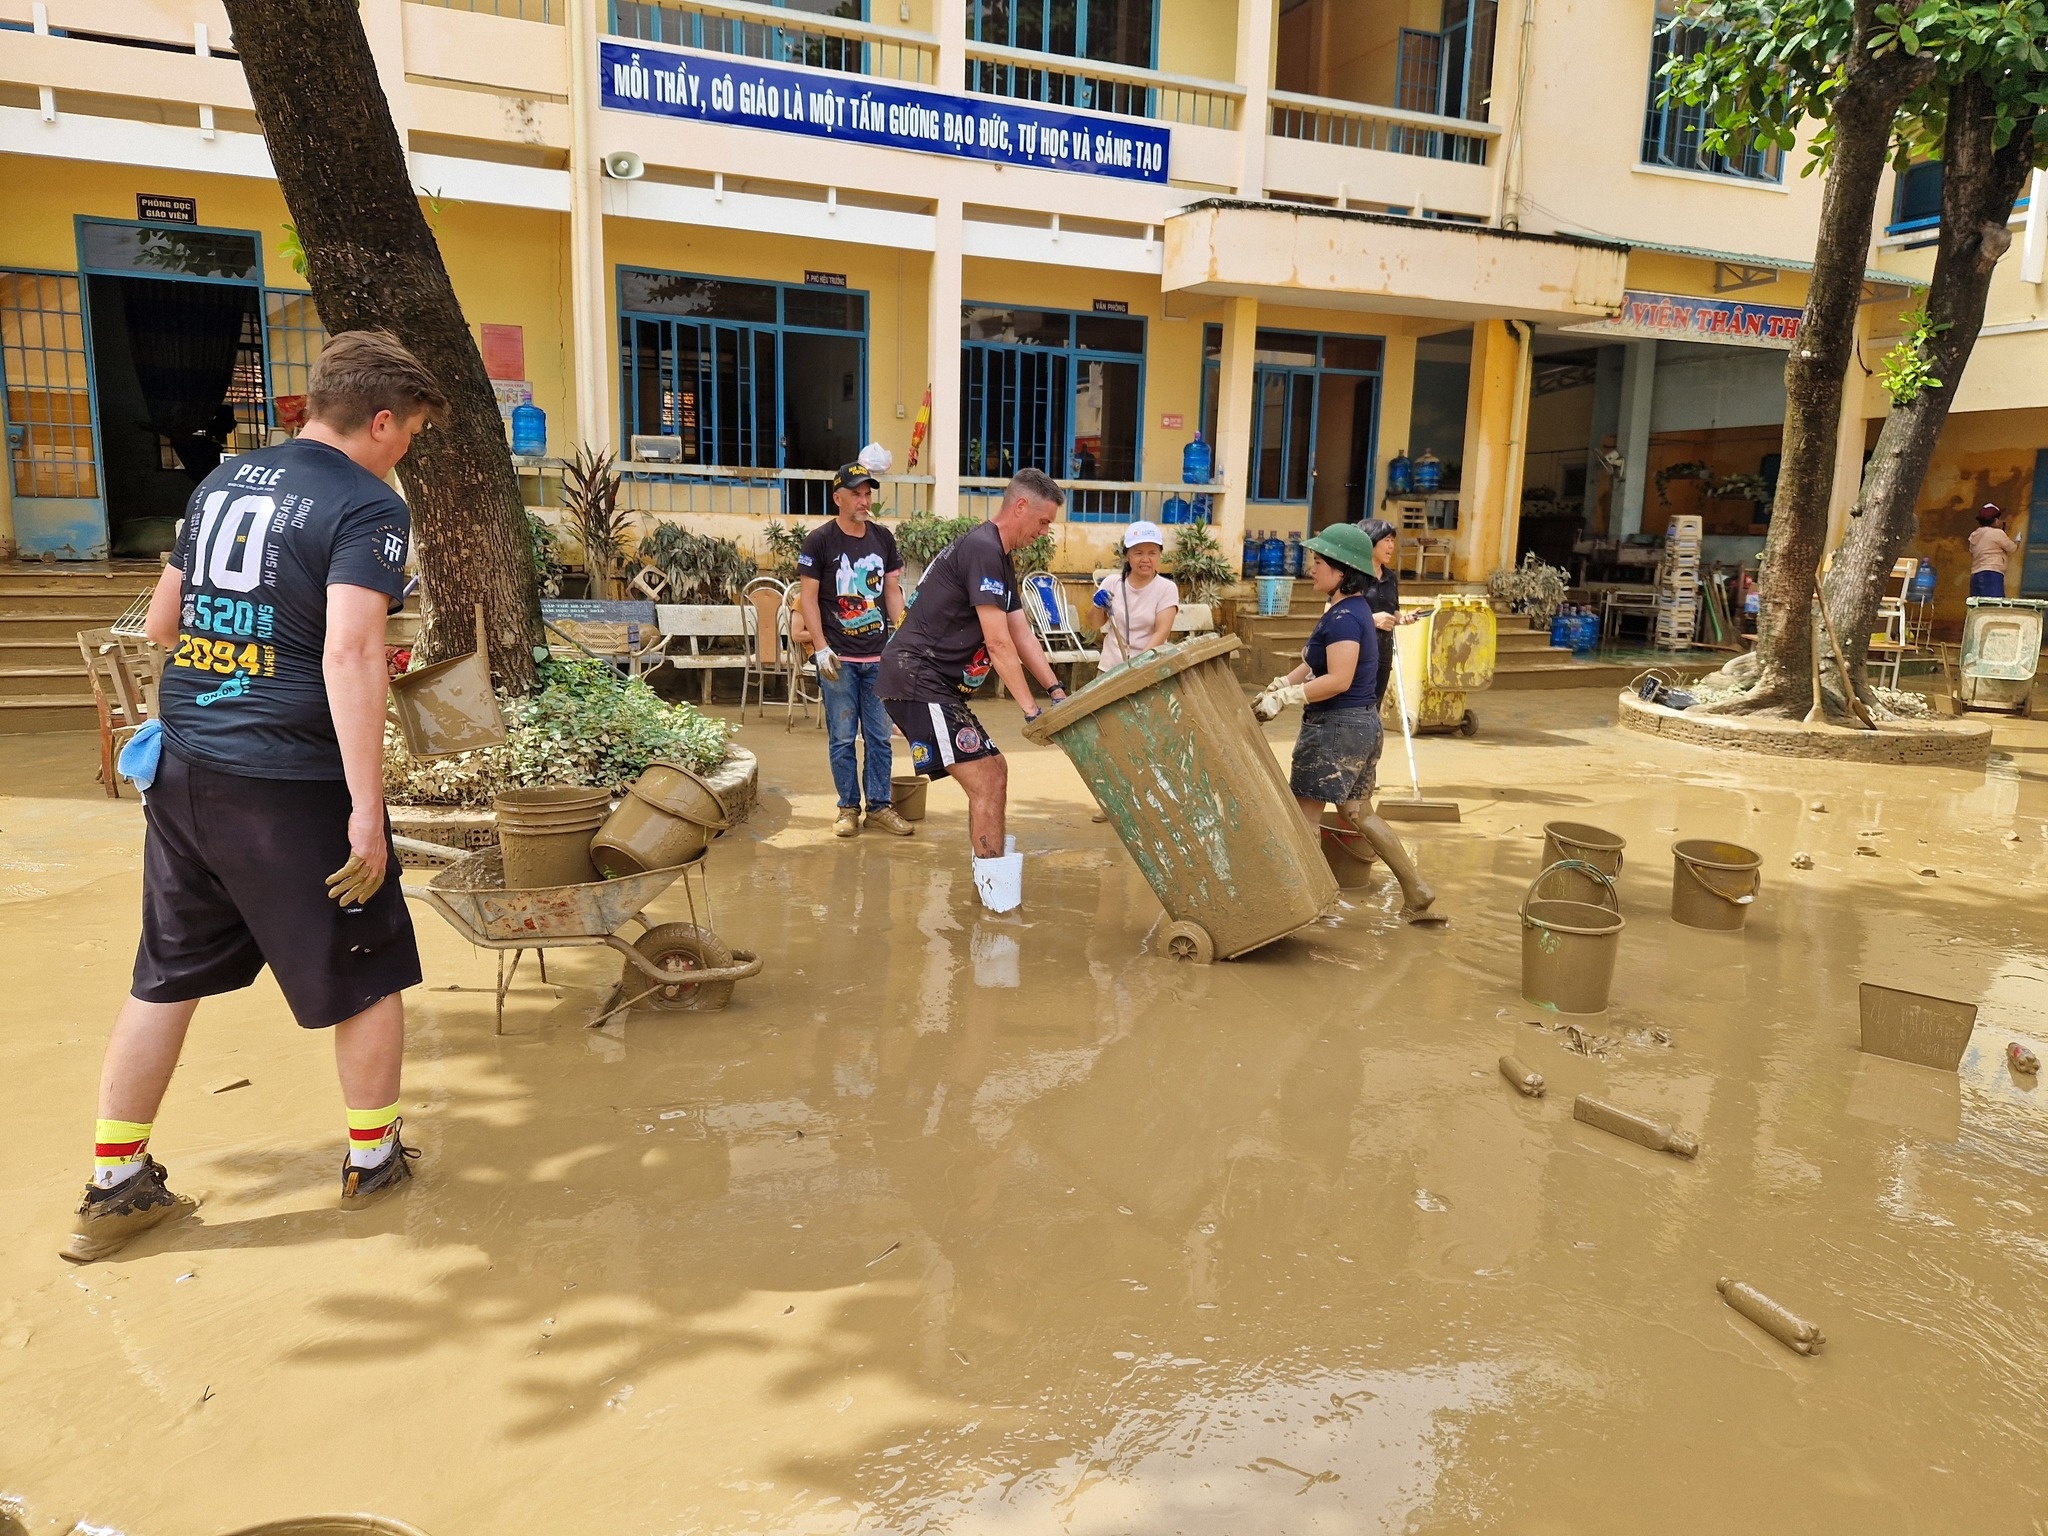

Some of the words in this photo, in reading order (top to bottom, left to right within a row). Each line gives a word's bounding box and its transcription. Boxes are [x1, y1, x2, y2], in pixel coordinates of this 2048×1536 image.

[614, 53, 649, 100] MỖI
[654, 61, 707, 115] THẦY,
[712, 73, 734, 112] CÔ
[739, 77, 779, 119] GIÁO
[784, 83, 804, 122] LÀ
[809, 88, 846, 133] MỘT
[849, 91, 885, 133] TẤM
[889, 102, 939, 141] GƯƠNG
[943, 112, 975, 151] ĐẠO
[978, 112, 1013, 156] ĐỨC,
[1017, 121, 1038, 160] TỰ
[1040, 127, 1069, 164] HỌC
[1072, 126, 1091, 161] VÀ
[1095, 130, 1132, 168] SÁNG
[1135, 141, 1162, 177] TẠO
[141, 198, 171, 208] PHÒNG
[173, 202, 191, 211] ĐỌC
[146, 209, 167, 218] GIÁO
[168, 211, 188, 220] VIÊN
[1095, 301, 1107, 311] VĂN
[1107, 302, 1126, 312] PHÒNG
[1632, 297, 1692, 334] VIỆN
[1696, 305, 1763, 337] THÂN
[1767, 316, 1801, 340] TH
[233, 463, 286, 487] PELE
[271, 492, 298, 534] DOSAGE
[290, 497, 314, 530] DINGO
[191, 490, 276, 593] 10
[265, 541, 281, 568] SHIT
[263, 570, 277, 588] AH
[194, 594, 253, 636] 520
[256, 604, 275, 640] RUNS
[173, 634, 260, 676] 2094
[203, 685, 236, 703] ON-ON
